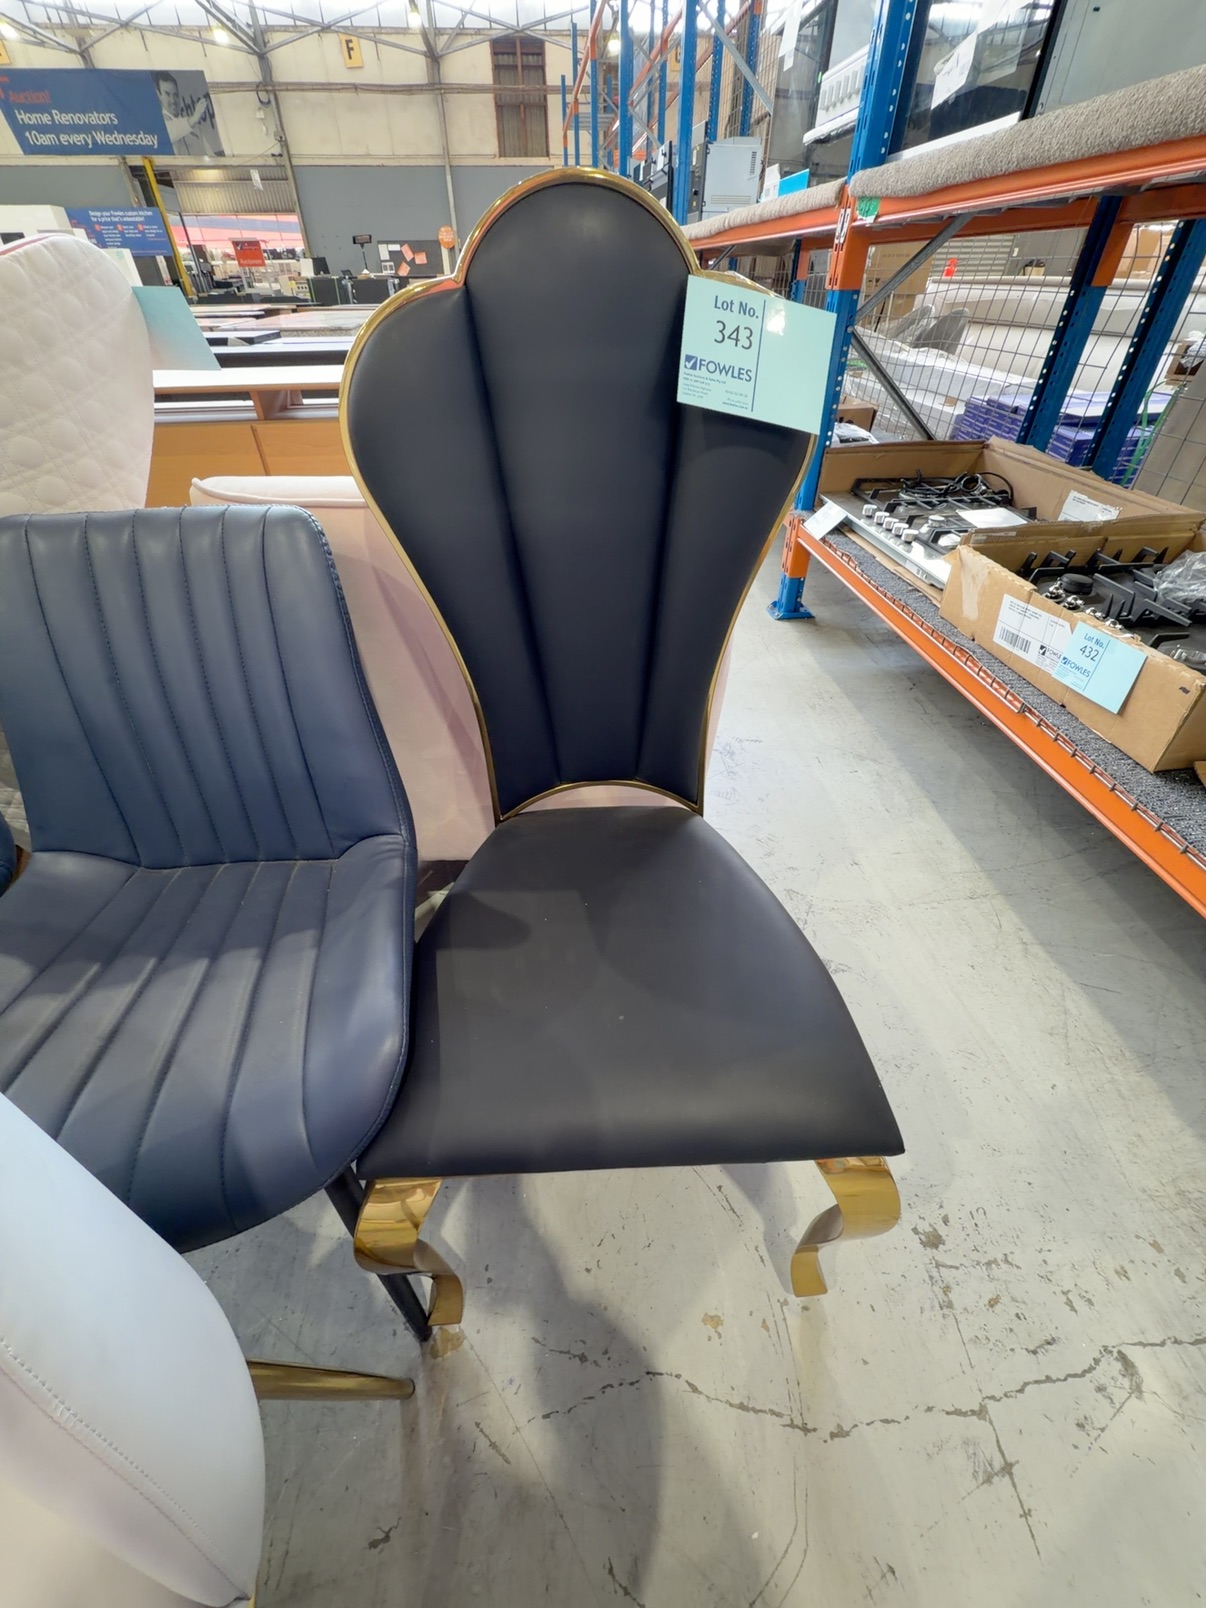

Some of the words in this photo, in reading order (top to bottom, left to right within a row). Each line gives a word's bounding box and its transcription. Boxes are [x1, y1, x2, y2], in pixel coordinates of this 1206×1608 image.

[345, 39, 354, 60] F
[15, 109, 52, 125] Home
[52, 110, 118, 125] Renovators
[25, 131, 59, 145] 10am
[60, 133, 93, 148] every
[92, 131, 158, 149] Wednesday
[714, 295, 734, 313] Lot
[738, 301, 759, 319] No.
[714, 320, 753, 350] 343
[699, 358, 752, 382] FOWLES
[1084, 633, 1095, 643] Lot
[1094, 638, 1104, 649] No.
[1080, 645, 1099, 662] 432
[1067, 659, 1091, 678] FOWLES
